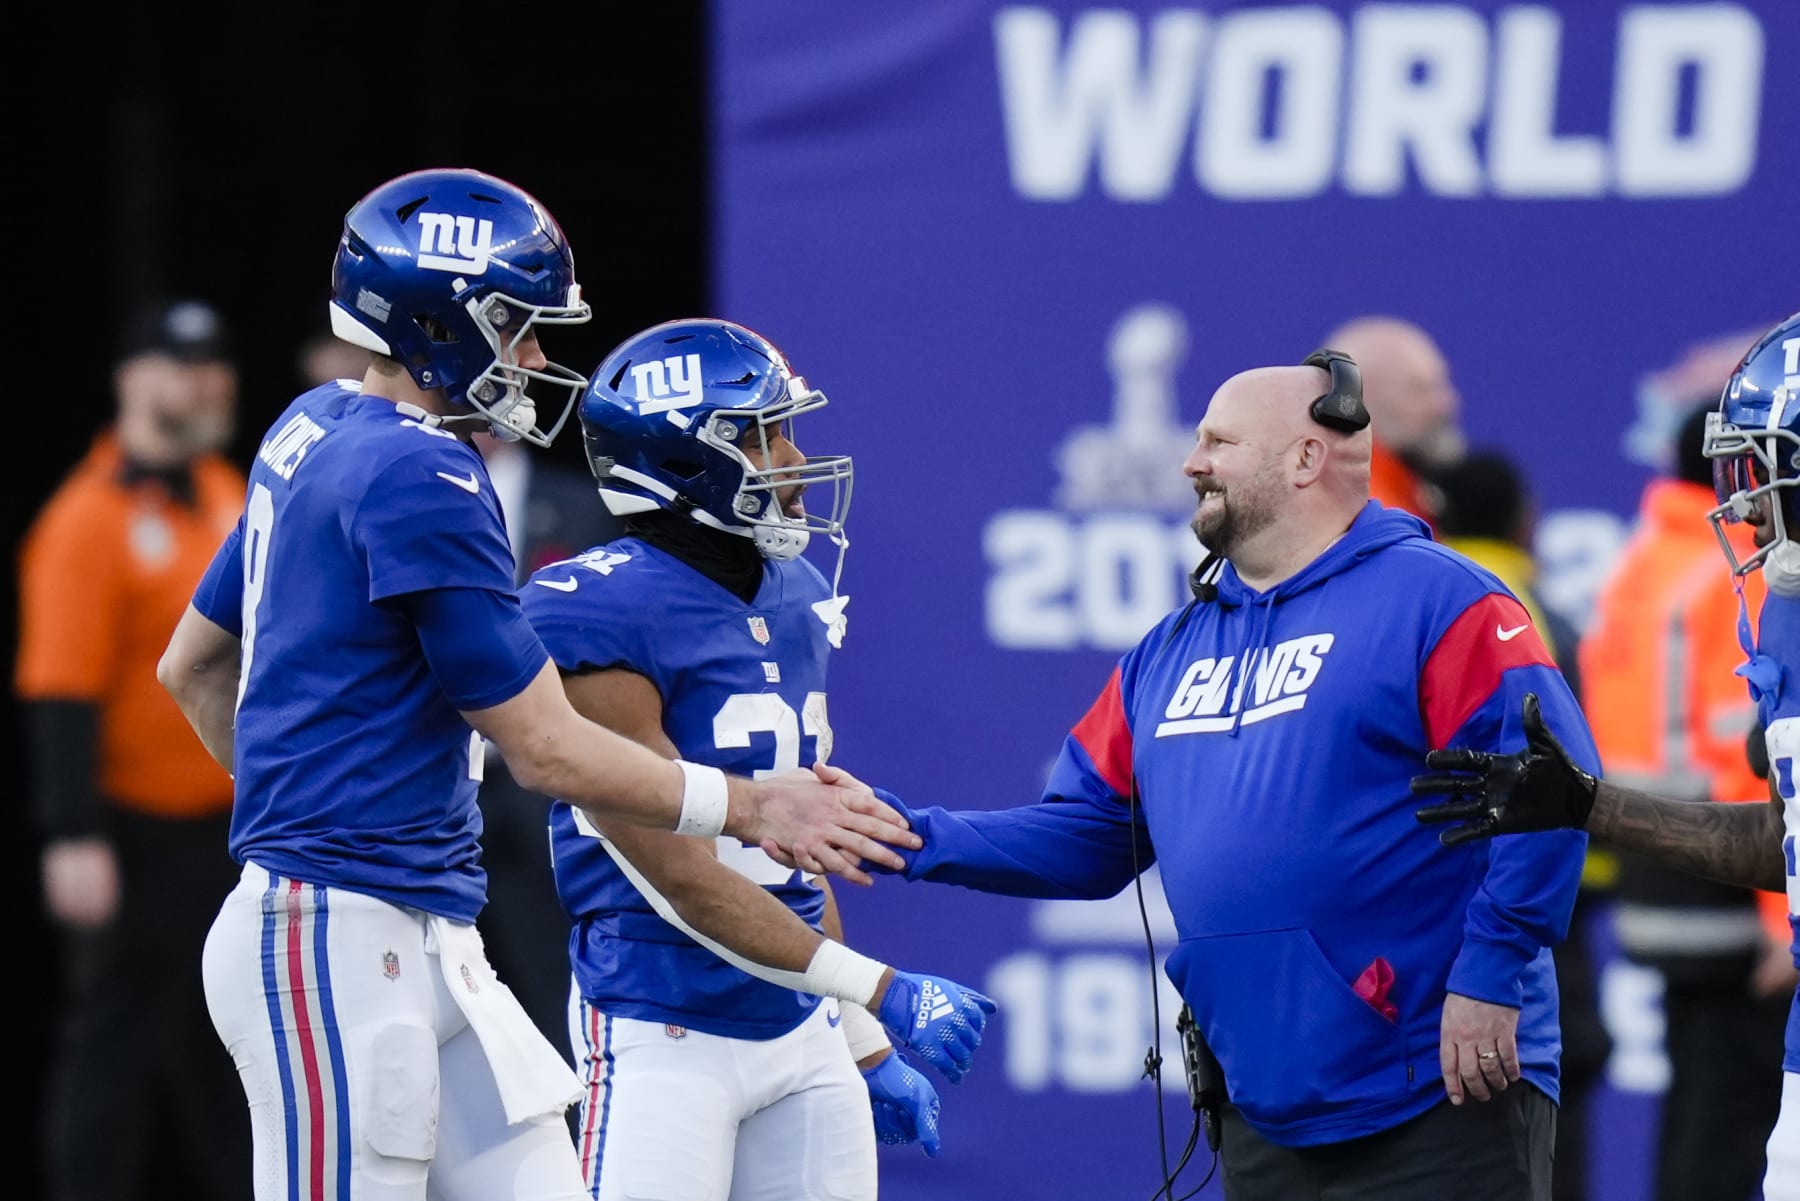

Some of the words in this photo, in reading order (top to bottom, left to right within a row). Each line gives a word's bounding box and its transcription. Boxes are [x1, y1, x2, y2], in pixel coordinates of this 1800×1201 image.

[994, 3, 1764, 200] WORLD
[260, 411, 326, 480] JONES
[1165, 633, 1335, 720] GIANTS
[916, 980, 933, 1029] adidas
